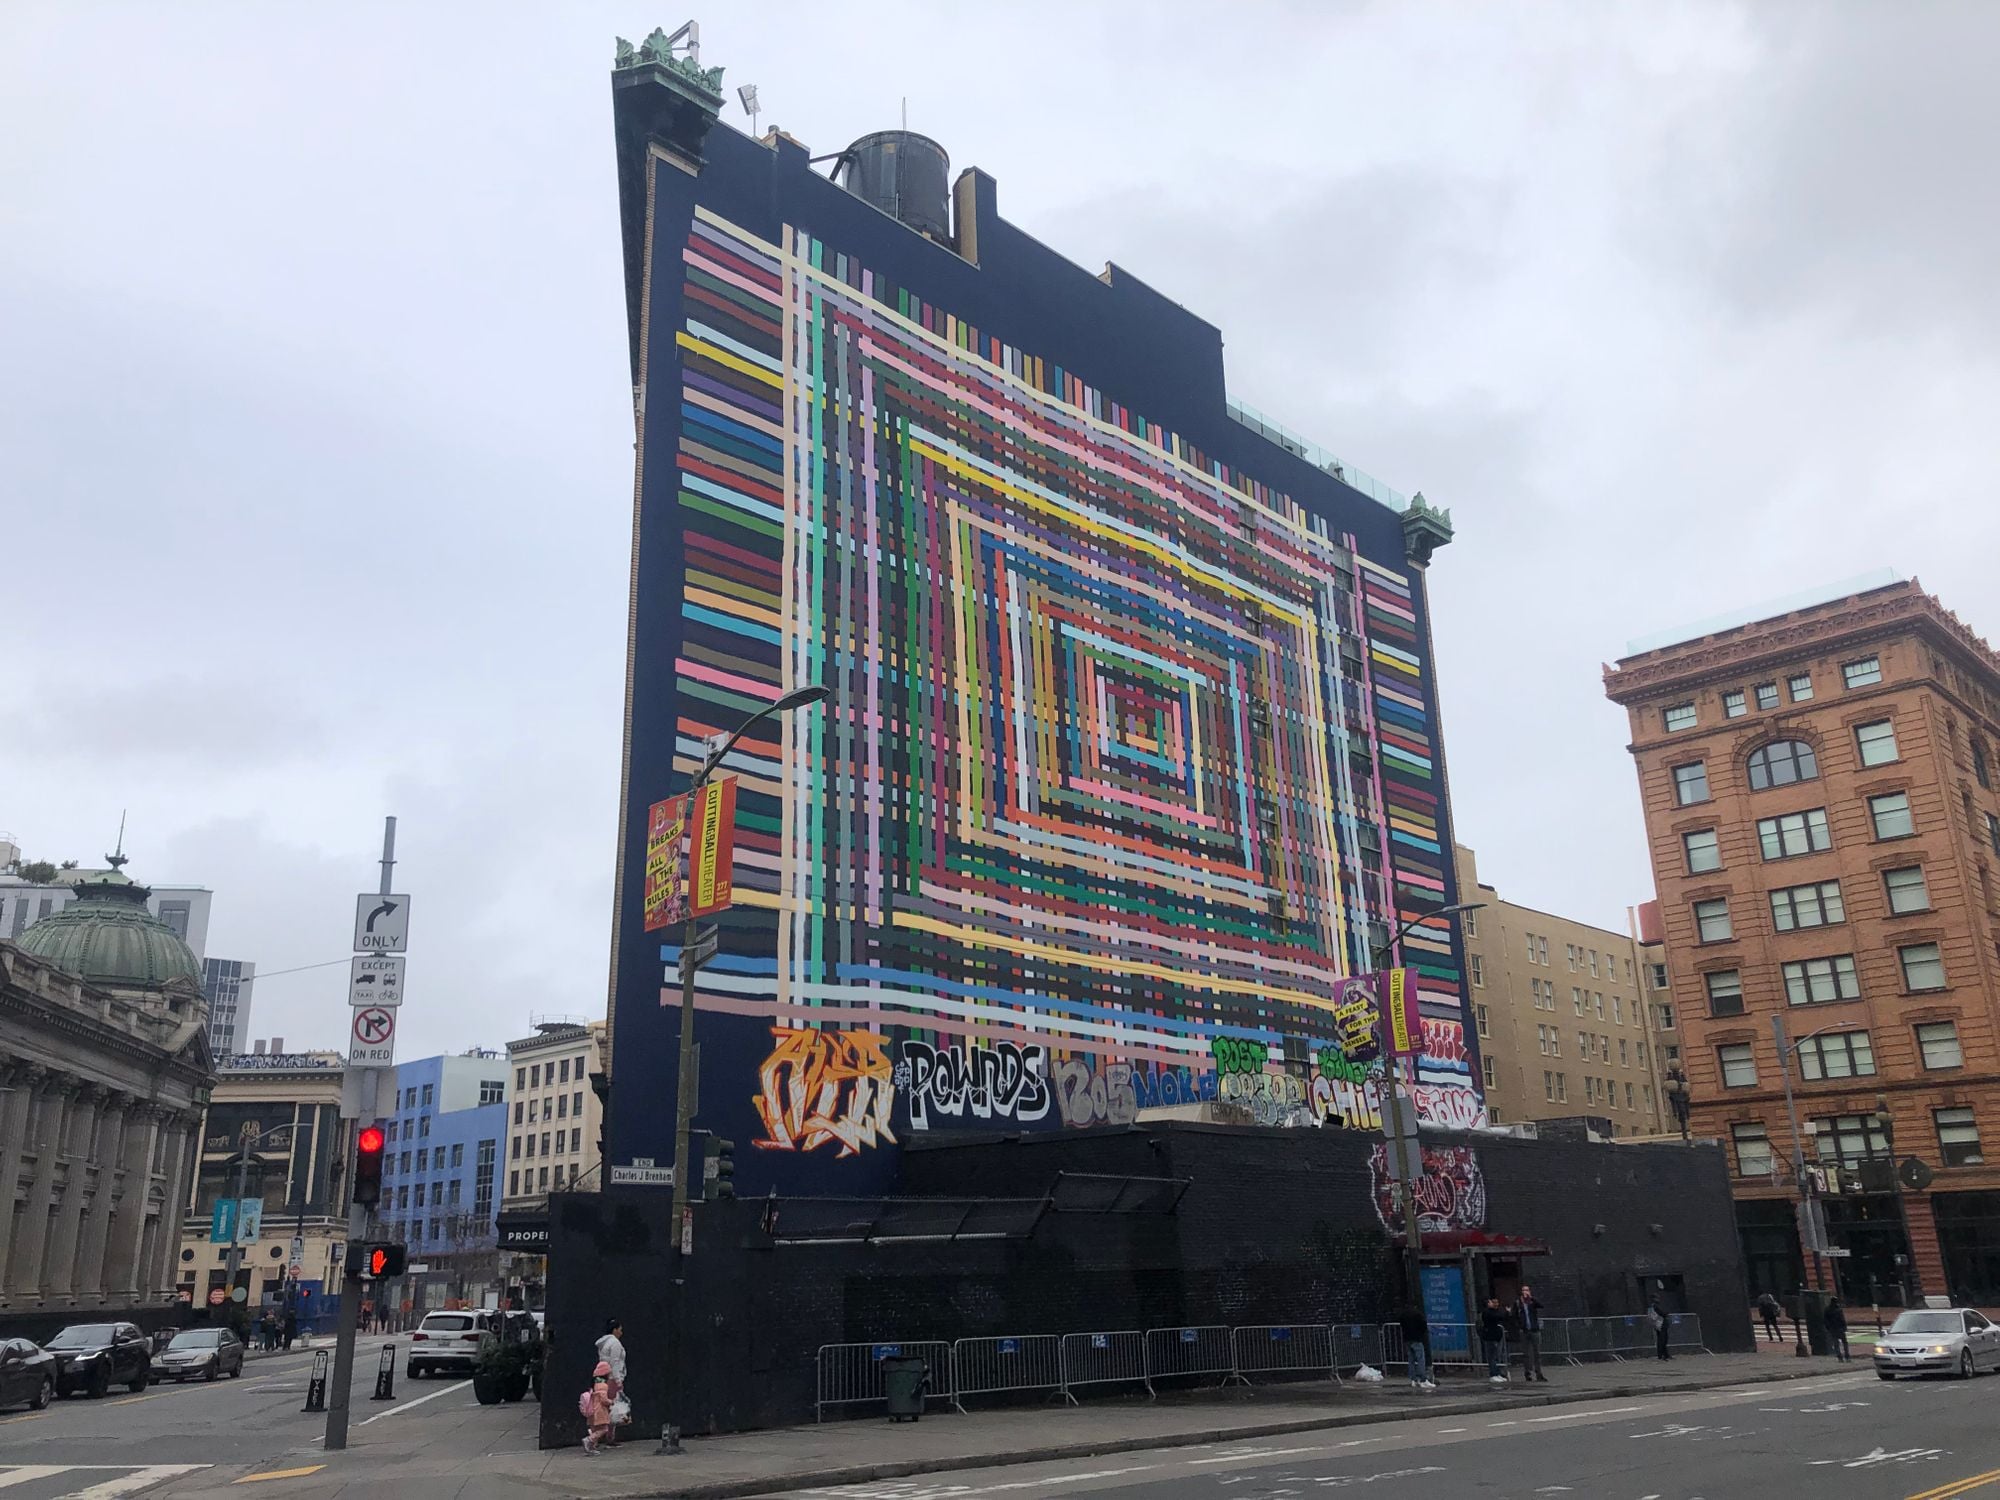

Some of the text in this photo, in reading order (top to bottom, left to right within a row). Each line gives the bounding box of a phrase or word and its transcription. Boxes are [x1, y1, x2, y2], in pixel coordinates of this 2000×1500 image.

[650, 826, 679, 850] BREAKS
[649, 856, 663, 870] ALL
[659, 867, 673, 880] THE
[647, 886, 670, 907] RULES
[362, 935, 399, 947] ONLY
[361, 961, 395, 970] EXCEPT
[1345, 1003, 1364, 1015] FEAST
[1349, 1016, 1376, 1030] FOR THE
[1344, 1035, 1367, 1047] SENSES
[352, 1049, 390, 1060] ON RED
[614, 1169, 637, 1180] Charles
[645, 1170, 672, 1181] Brenham
